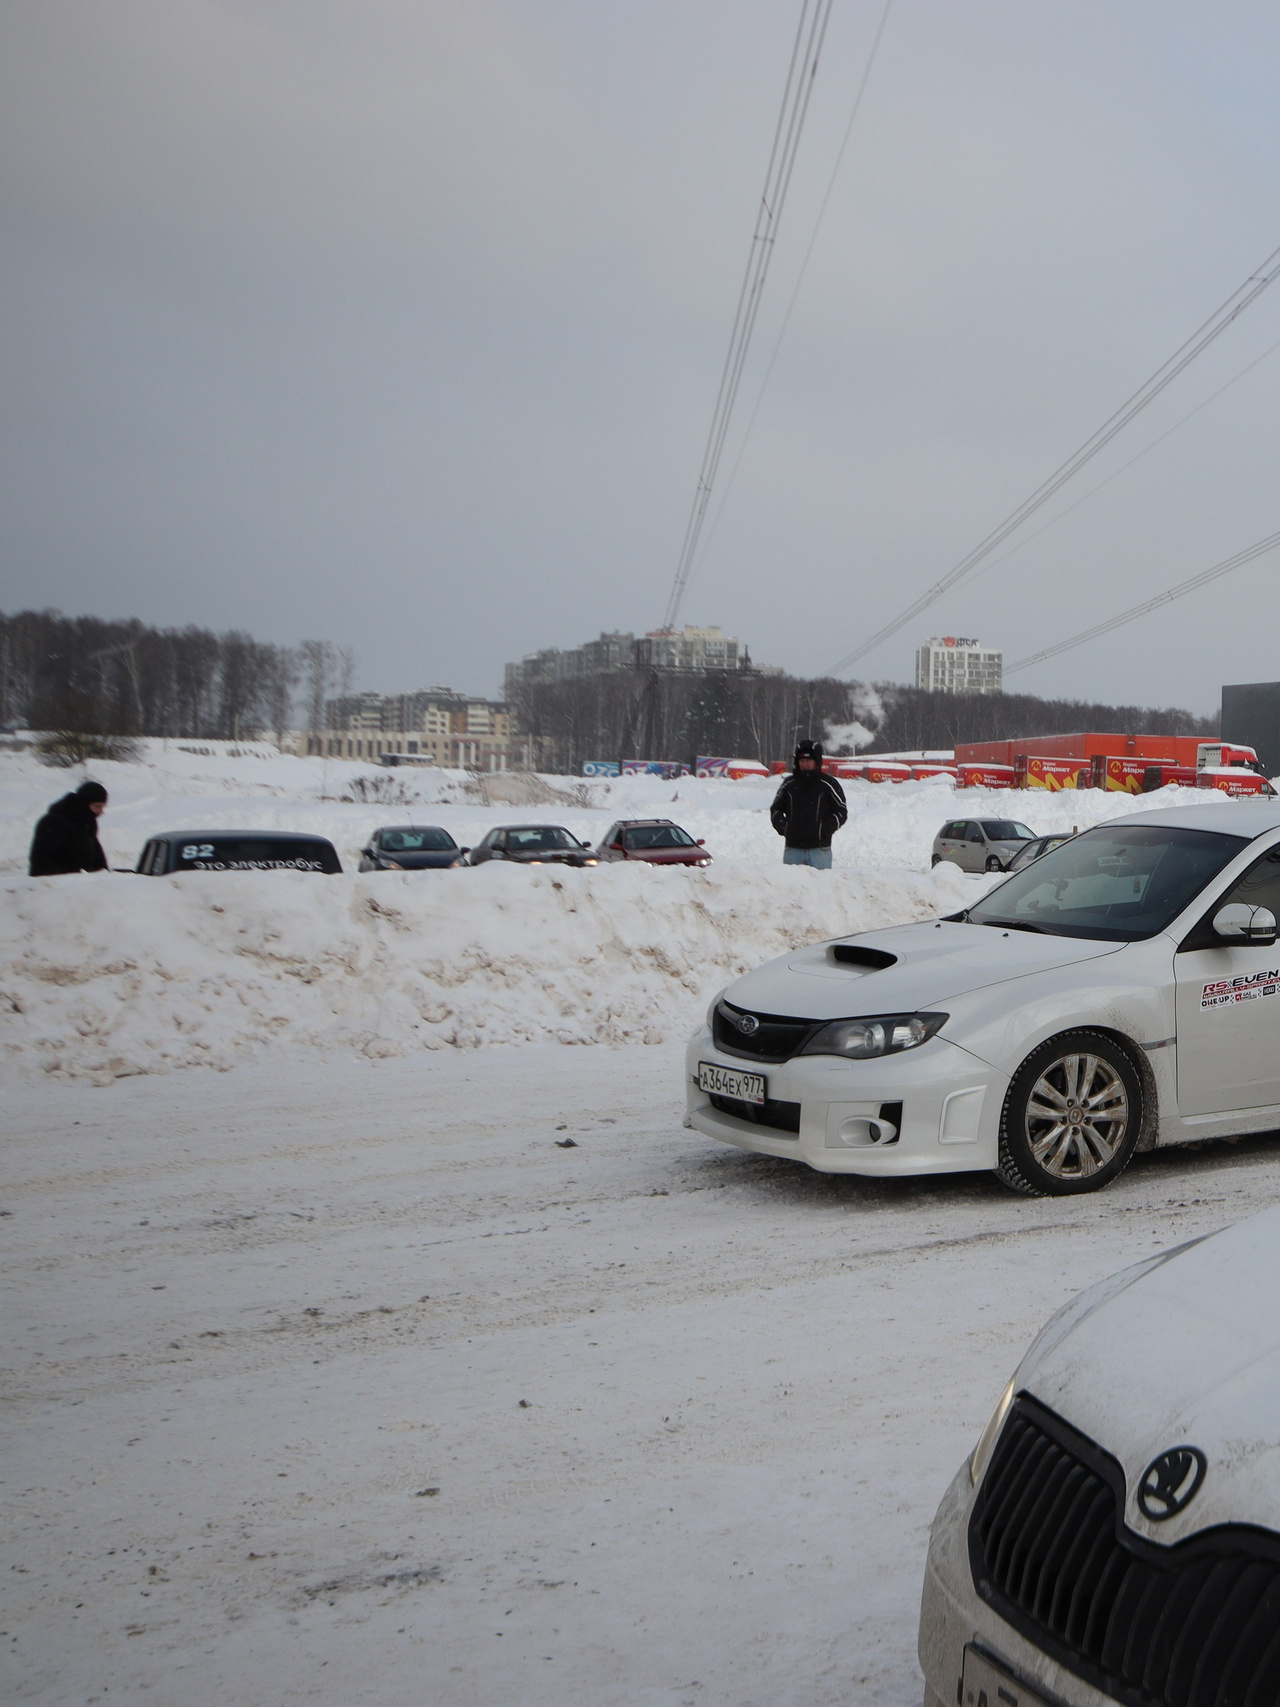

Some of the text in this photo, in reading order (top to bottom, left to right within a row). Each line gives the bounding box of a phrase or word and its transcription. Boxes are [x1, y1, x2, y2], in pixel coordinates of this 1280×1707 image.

[182, 844, 214, 860] 82
[1203, 981, 1228, 993] RS
[743, 1075, 761, 1094] 977
